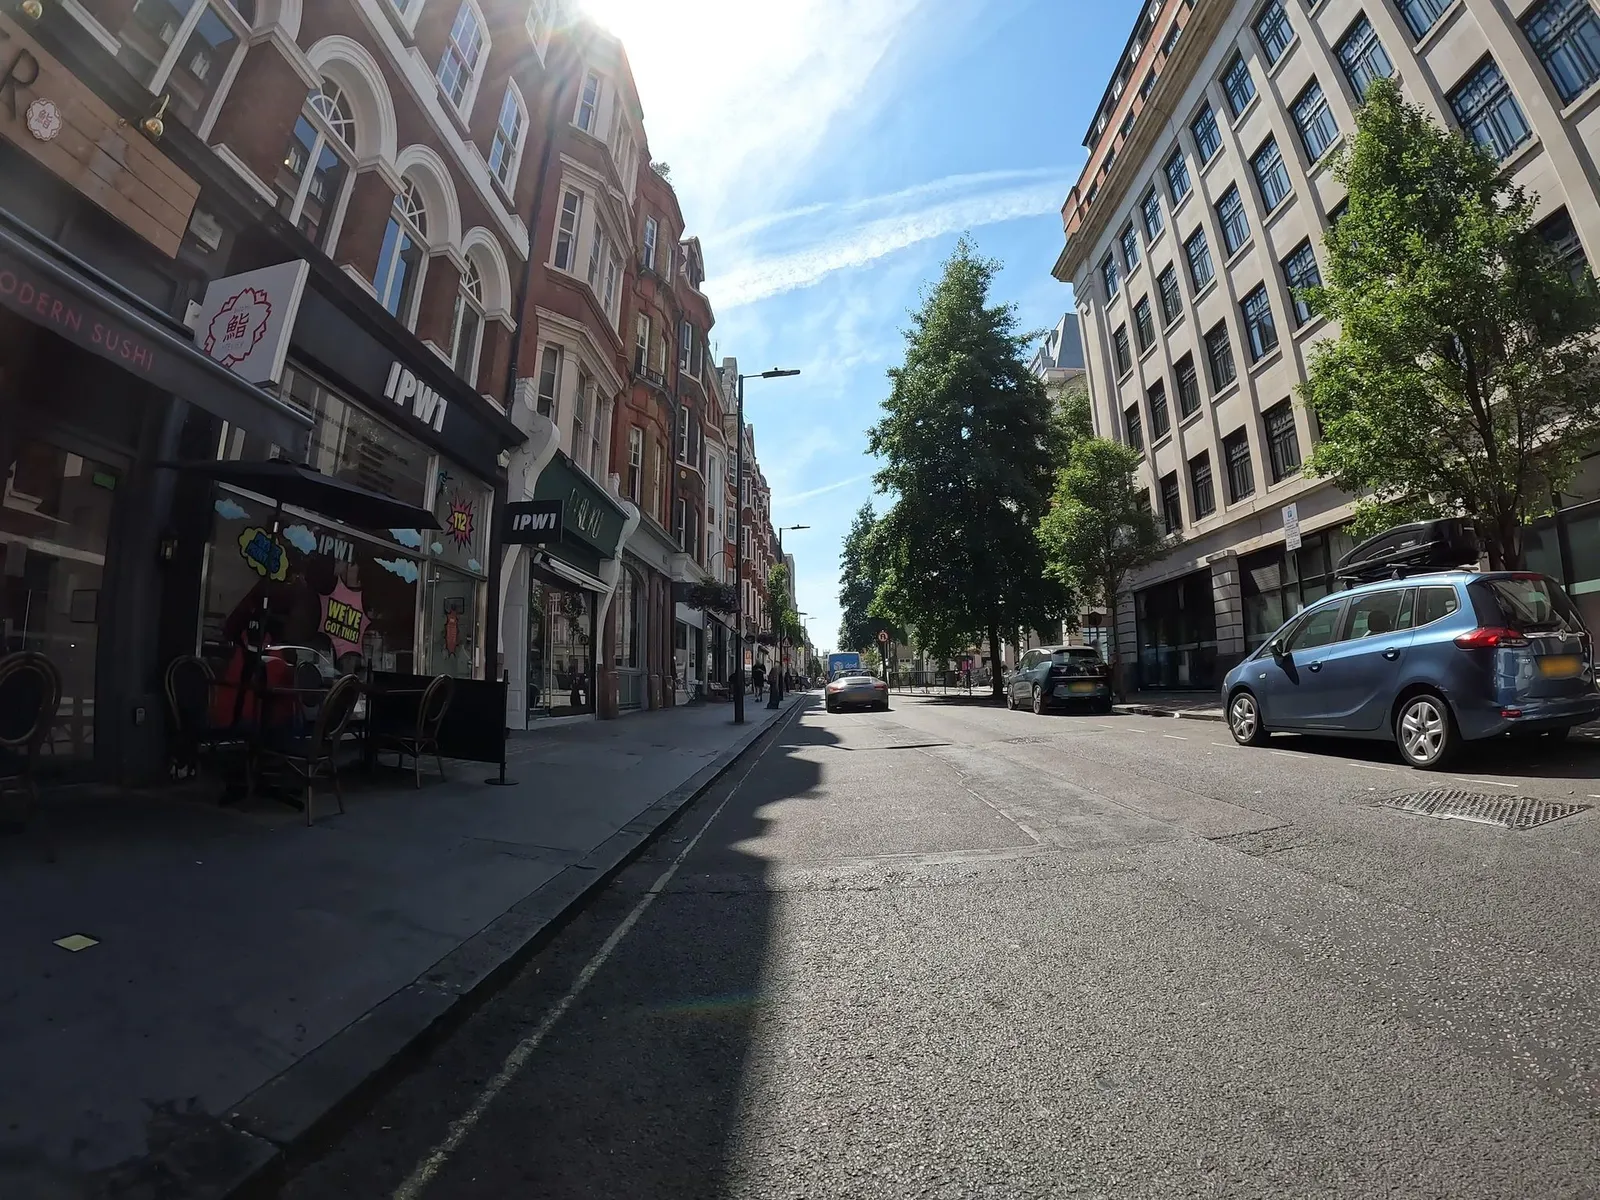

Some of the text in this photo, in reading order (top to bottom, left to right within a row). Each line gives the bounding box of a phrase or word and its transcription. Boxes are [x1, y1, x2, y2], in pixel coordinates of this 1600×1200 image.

[222, 312, 250, 342] 鮨
[91, 324, 154, 371] SUSHI
[383, 361, 448, 433] IPW1
[454, 511, 467, 532] 112
[512, 513, 557, 531] IPW1
[318, 534, 354, 562] IPW1
[328, 599, 362, 629] WE'VE
[325, 620, 359, 643] GOT THIS!
